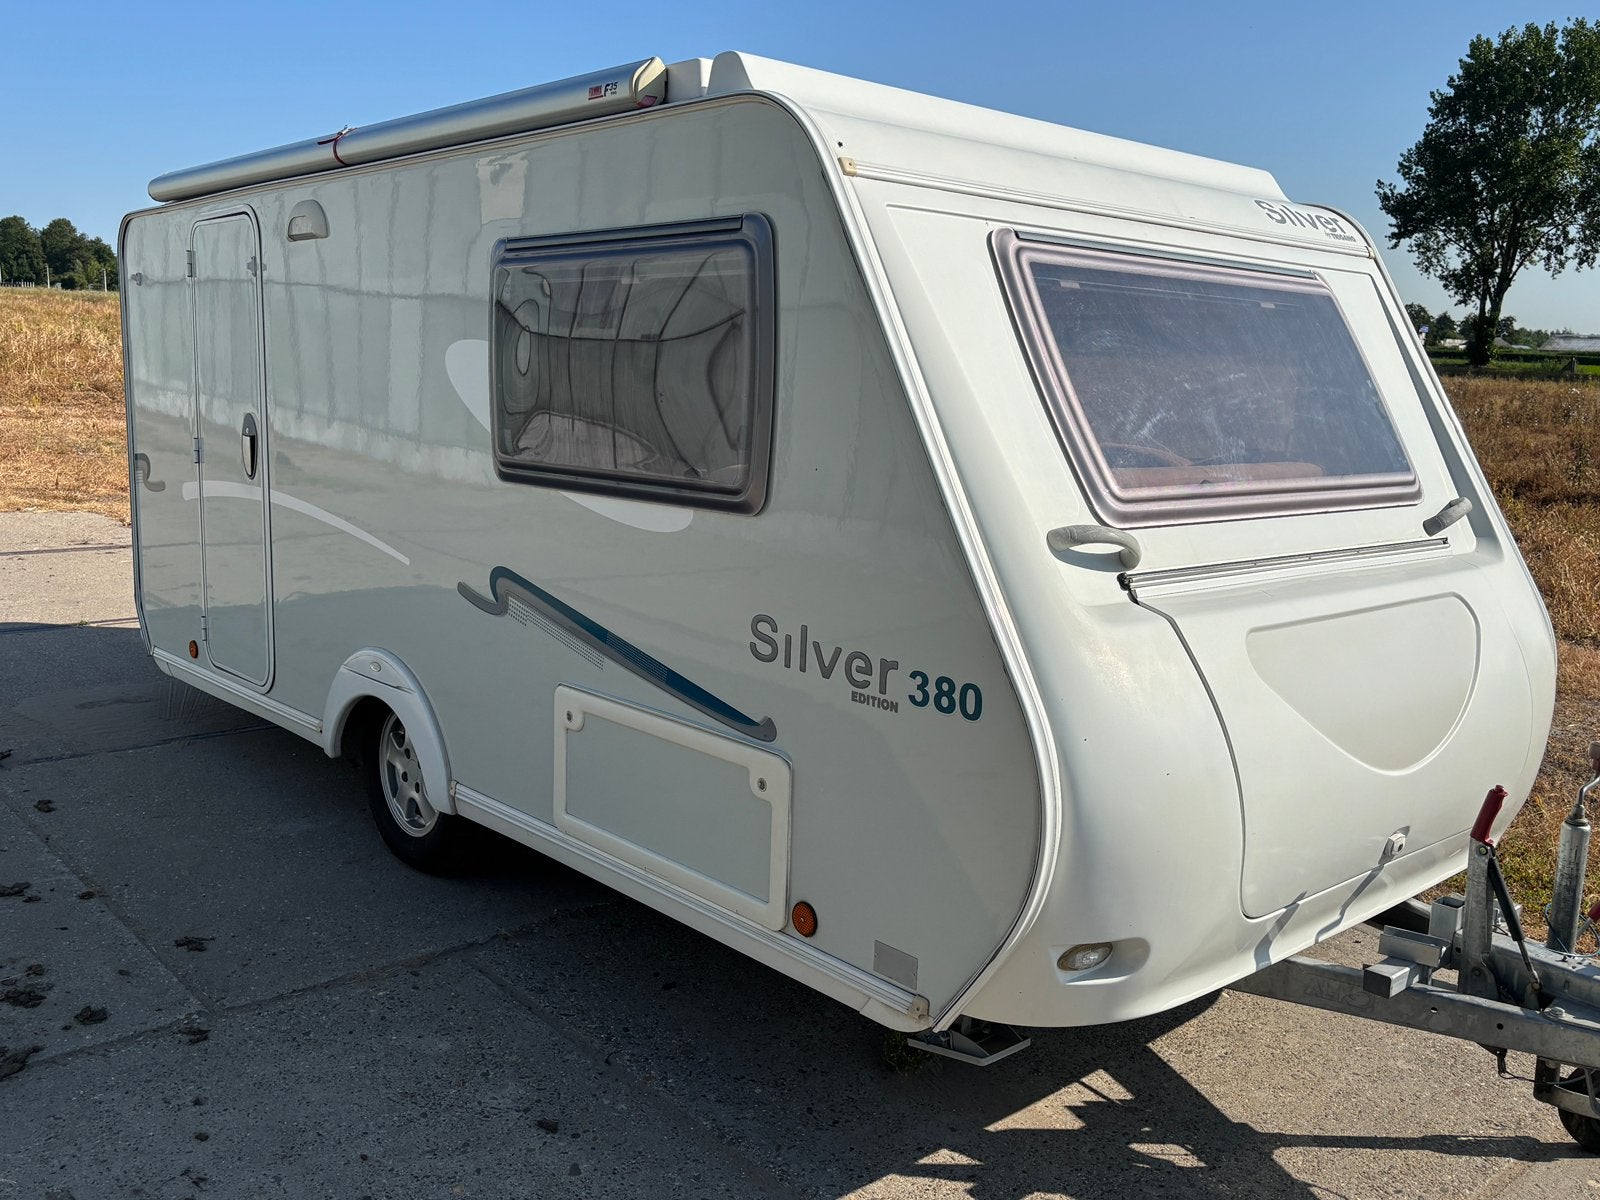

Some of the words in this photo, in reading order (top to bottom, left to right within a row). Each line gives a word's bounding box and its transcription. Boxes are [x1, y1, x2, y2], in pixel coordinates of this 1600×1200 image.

[1255, 200, 1346, 234] Silver
[749, 613, 899, 695] Silver
[908, 670, 983, 722] 380
[851, 690, 899, 713] EDITION
